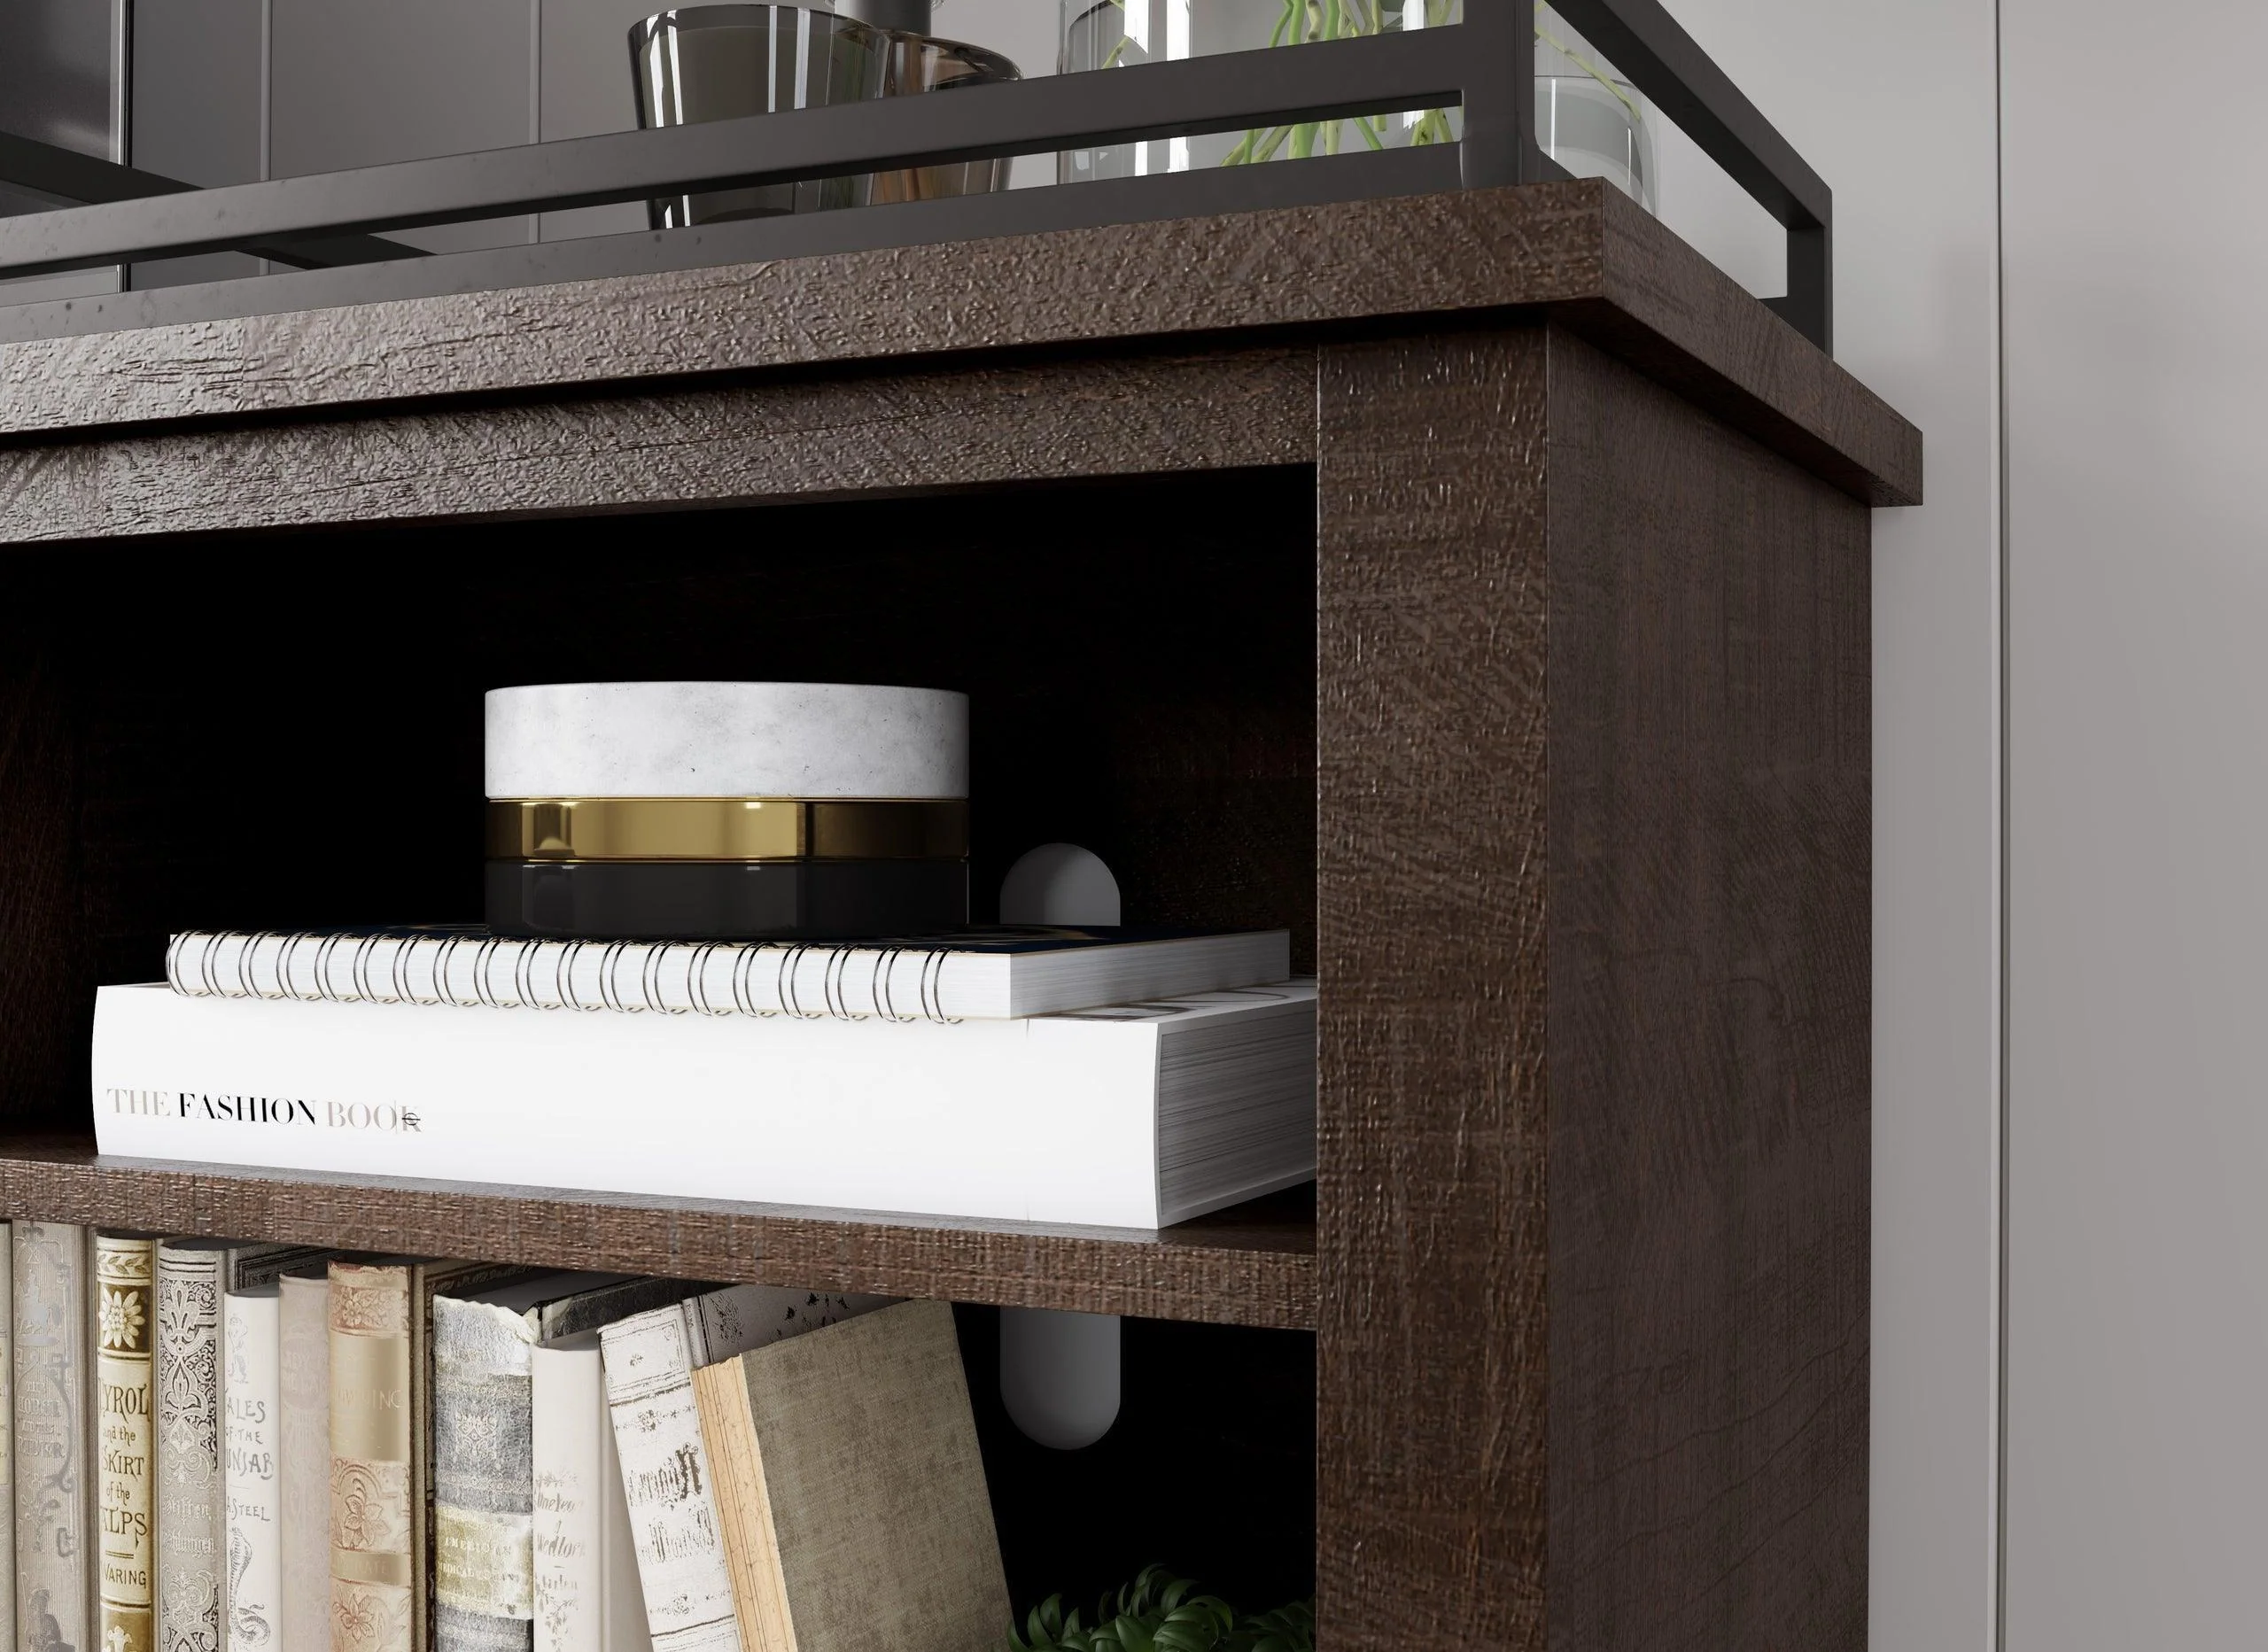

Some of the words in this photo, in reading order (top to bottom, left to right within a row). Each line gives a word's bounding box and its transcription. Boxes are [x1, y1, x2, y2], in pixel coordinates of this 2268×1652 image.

[106, 1088, 171, 1117] THE
[178, 1091, 317, 1126] FASHION
[325, 1099, 426, 1134] BOOK
[225, 1389, 266, 1424] ALES
[119, 1425, 136, 1447] the
[237, 1427, 263, 1445] THE
[103, 1445, 144, 1482] SKIRT
[225, 1446, 275, 1481] UNJAB
[116, 1482, 131, 1507] the
